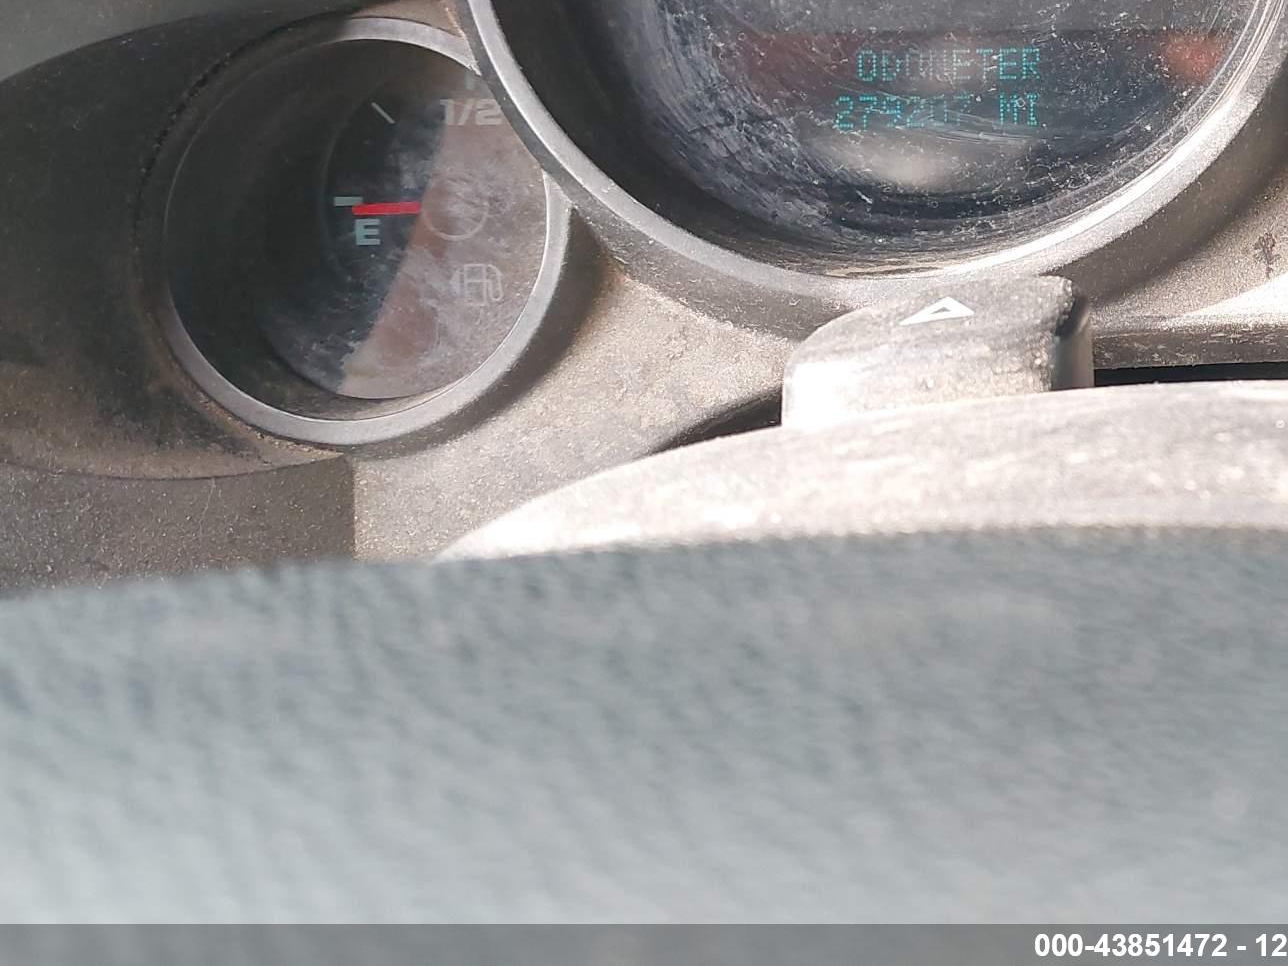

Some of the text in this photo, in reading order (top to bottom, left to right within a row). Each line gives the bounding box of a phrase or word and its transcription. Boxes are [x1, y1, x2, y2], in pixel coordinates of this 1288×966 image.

[440, 98, 502, 125] 1/2
[999, 94, 1039, 126] MI
[355, 219, 381, 246] E
